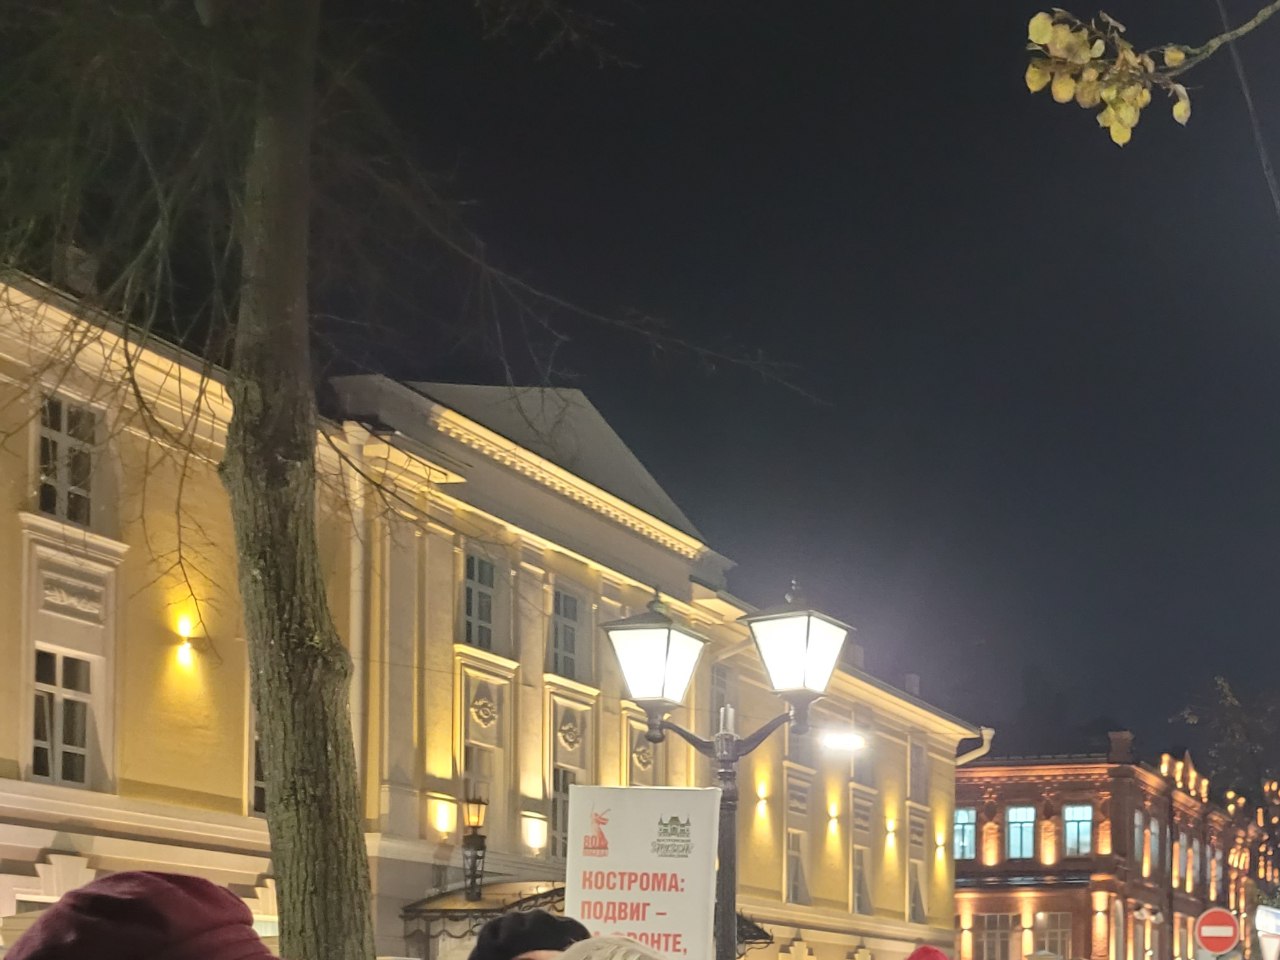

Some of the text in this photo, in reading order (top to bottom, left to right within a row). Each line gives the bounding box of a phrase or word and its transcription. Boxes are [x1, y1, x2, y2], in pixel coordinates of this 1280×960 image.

[581, 870, 686, 893] КОСТРОМА:
[580, 901, 651, 924] ПОДВИГ
[611, 931, 688, 955] ОНТЕ,
